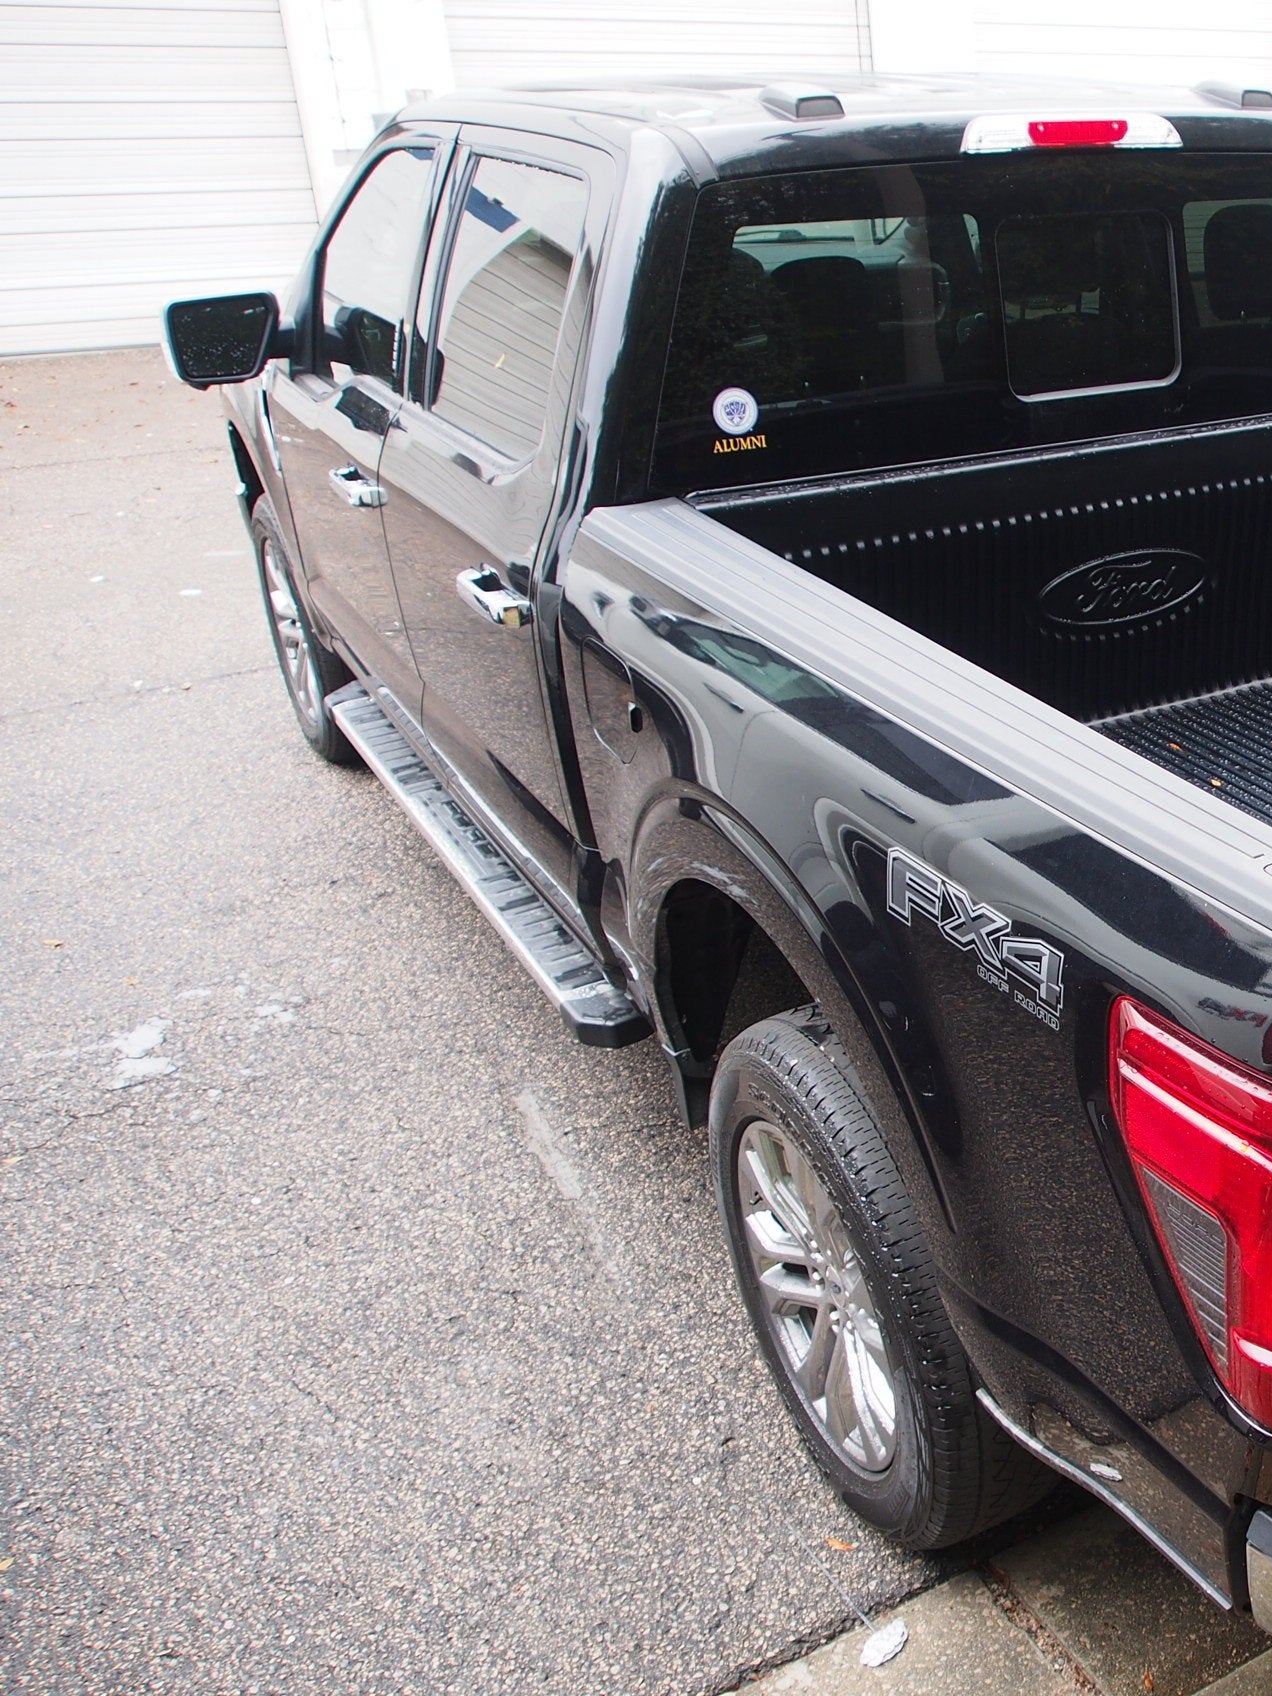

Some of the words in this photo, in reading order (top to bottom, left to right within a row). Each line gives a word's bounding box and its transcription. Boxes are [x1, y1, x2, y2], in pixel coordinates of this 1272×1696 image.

[713, 434, 768, 454] ALUMNI
[1075, 560, 1176, 612] Ford
[887, 847, 1064, 1016] FX4
[977, 964, 1010, 993] OFF
[1014, 989, 1060, 1031] ROAD
